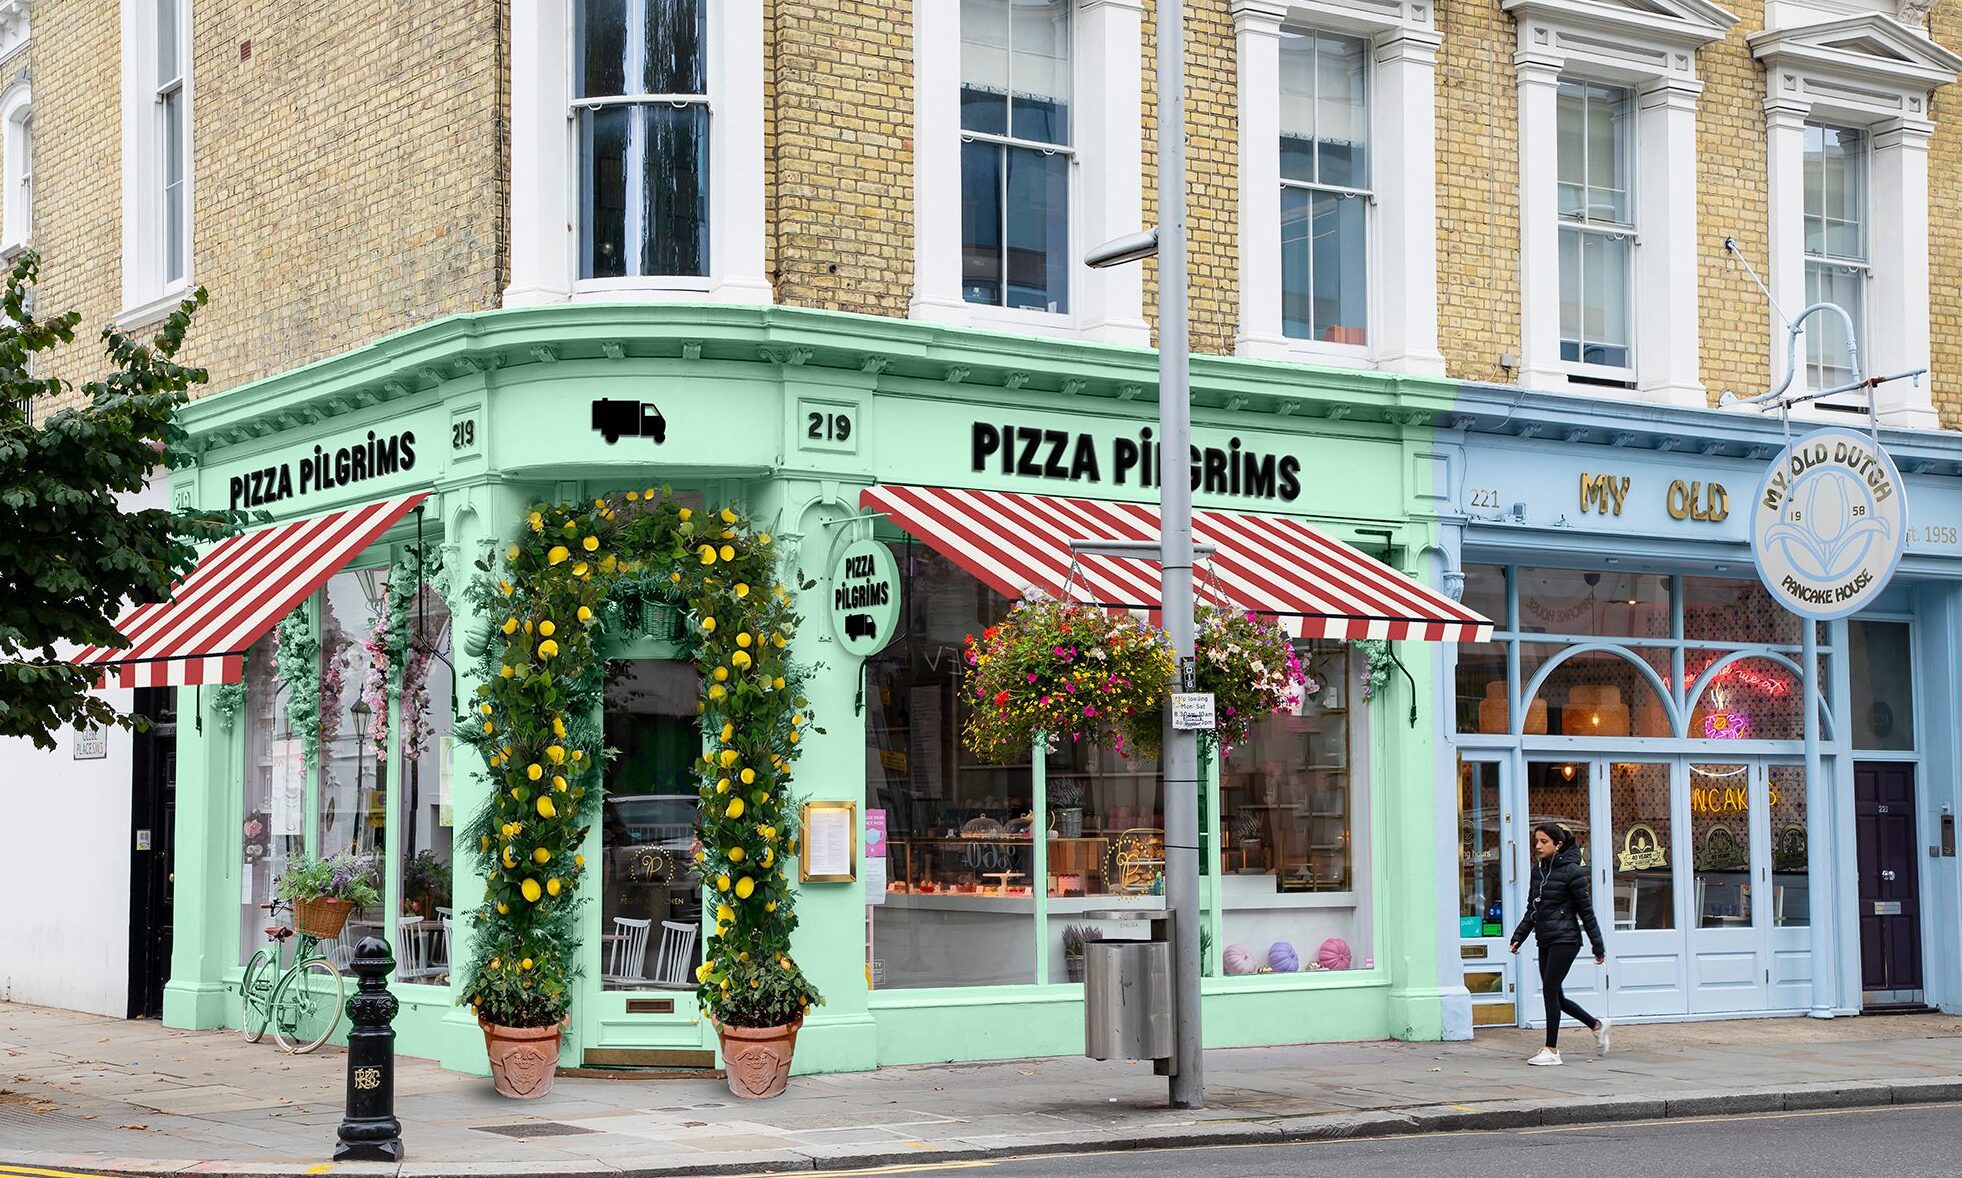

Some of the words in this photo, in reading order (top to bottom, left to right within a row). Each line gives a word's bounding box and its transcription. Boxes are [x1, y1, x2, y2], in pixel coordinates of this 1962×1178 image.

[452, 419, 475, 448] 219
[808, 412, 852, 441] 219
[972, 421, 1101, 482] PIZZA
[230, 463, 293, 511] PIZZA
[1763, 471, 1788, 511] MY
[1791, 443, 1828, 476] OLD
[1834, 442, 1893, 502] DUTCH
[1470, 488, 1500, 508] 221
[1579, 472, 1631, 516] MY
[1666, 479, 1729, 522] OLD
[1790, 511, 1802, 522] 19
[1852, 505, 1866, 516] 58
[1925, 526, 1957, 544] 1958
[846, 554, 875, 579] PIZZA
[1781, 574, 1833, 604] PANCAKE
[1835, 568, 1874, 602] HOUSE
[1472, 849, 1491, 859] hours
